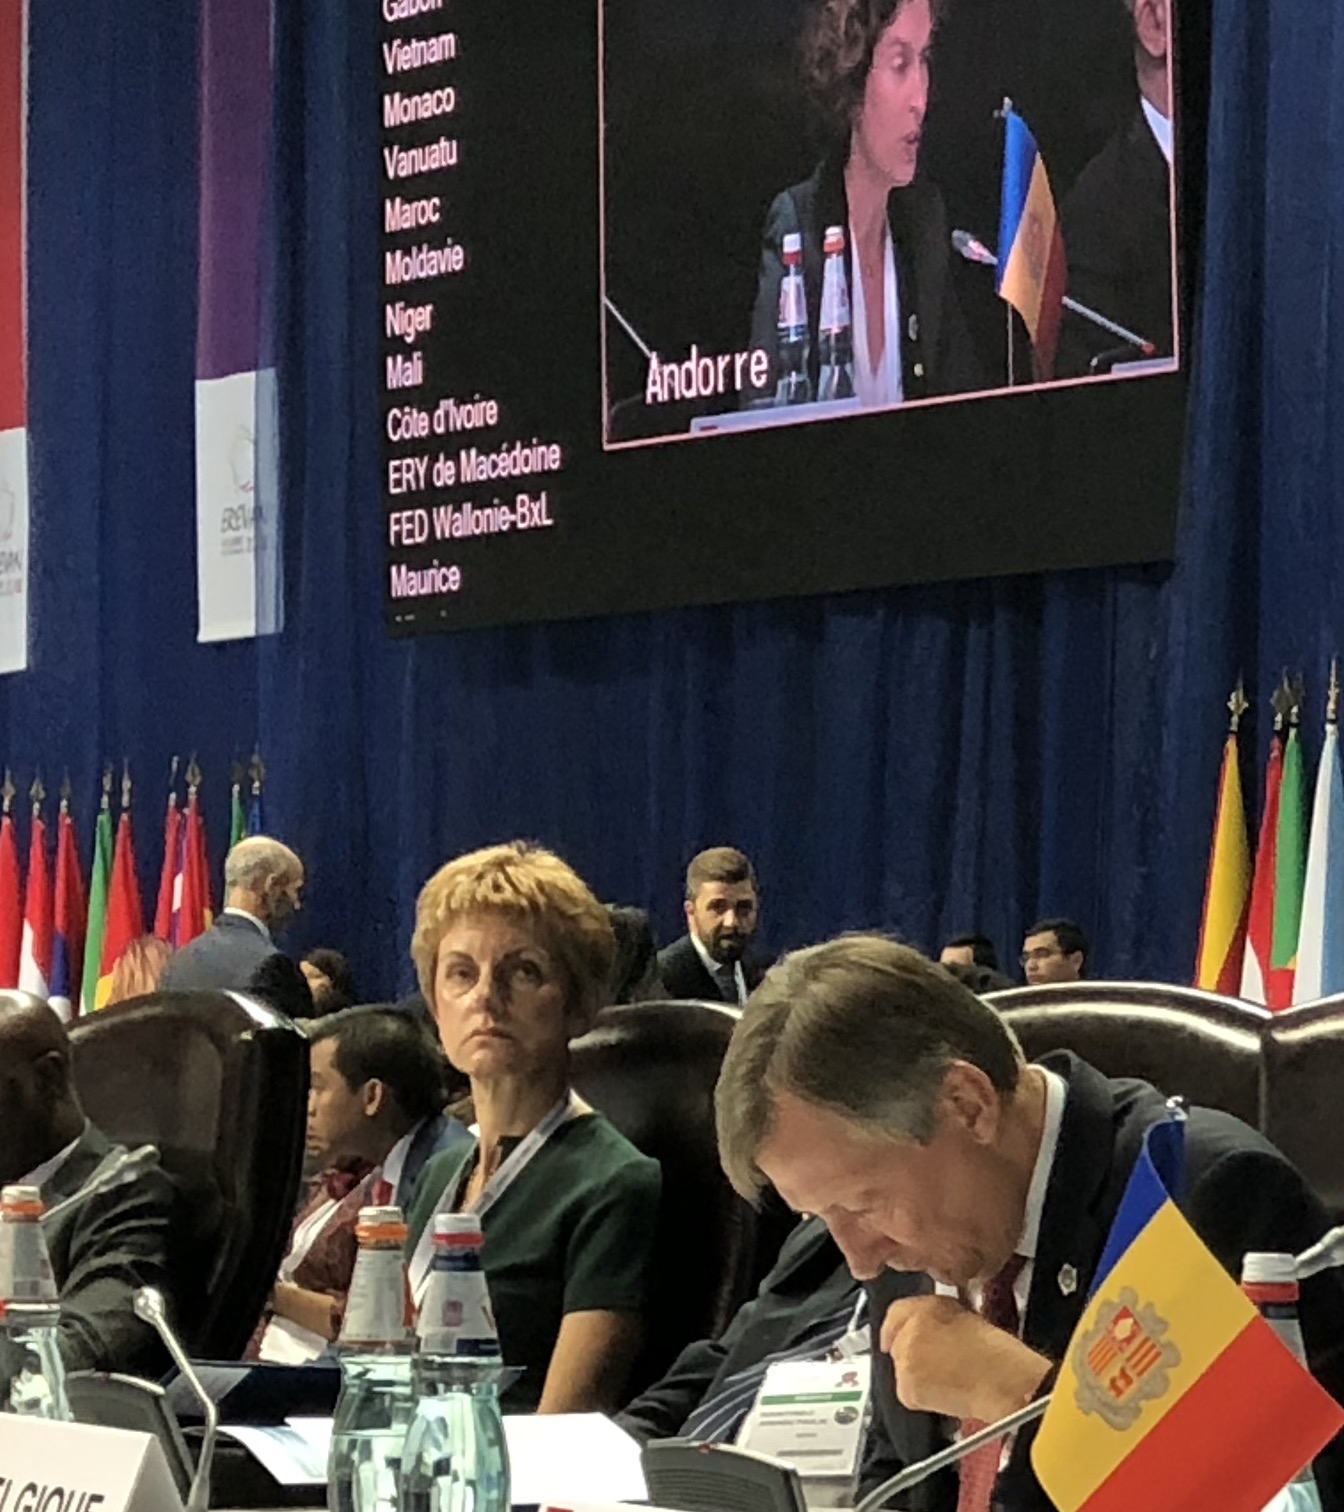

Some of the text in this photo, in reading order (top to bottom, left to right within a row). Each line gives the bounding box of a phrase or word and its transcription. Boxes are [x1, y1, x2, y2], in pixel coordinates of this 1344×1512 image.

[383, 32, 456, 75] Vietnam
[383, 86, 455, 128] Monaco
[384, 135, 458, 180] Vanuatu
[385, 196, 440, 233] Maroc
[385, 238, 464, 285] Moldavie
[386, 302, 433, 344] Niger
[386, 351, 423, 389] Mali
[646, 344, 769, 404] Andorre
[387, 405, 429, 442] Côte
[388, 437, 562, 494] ERY de Macédoine
[390, 491, 554, 546] FED Wallonie-BxL
[390, 559, 461, 598] Maurice
